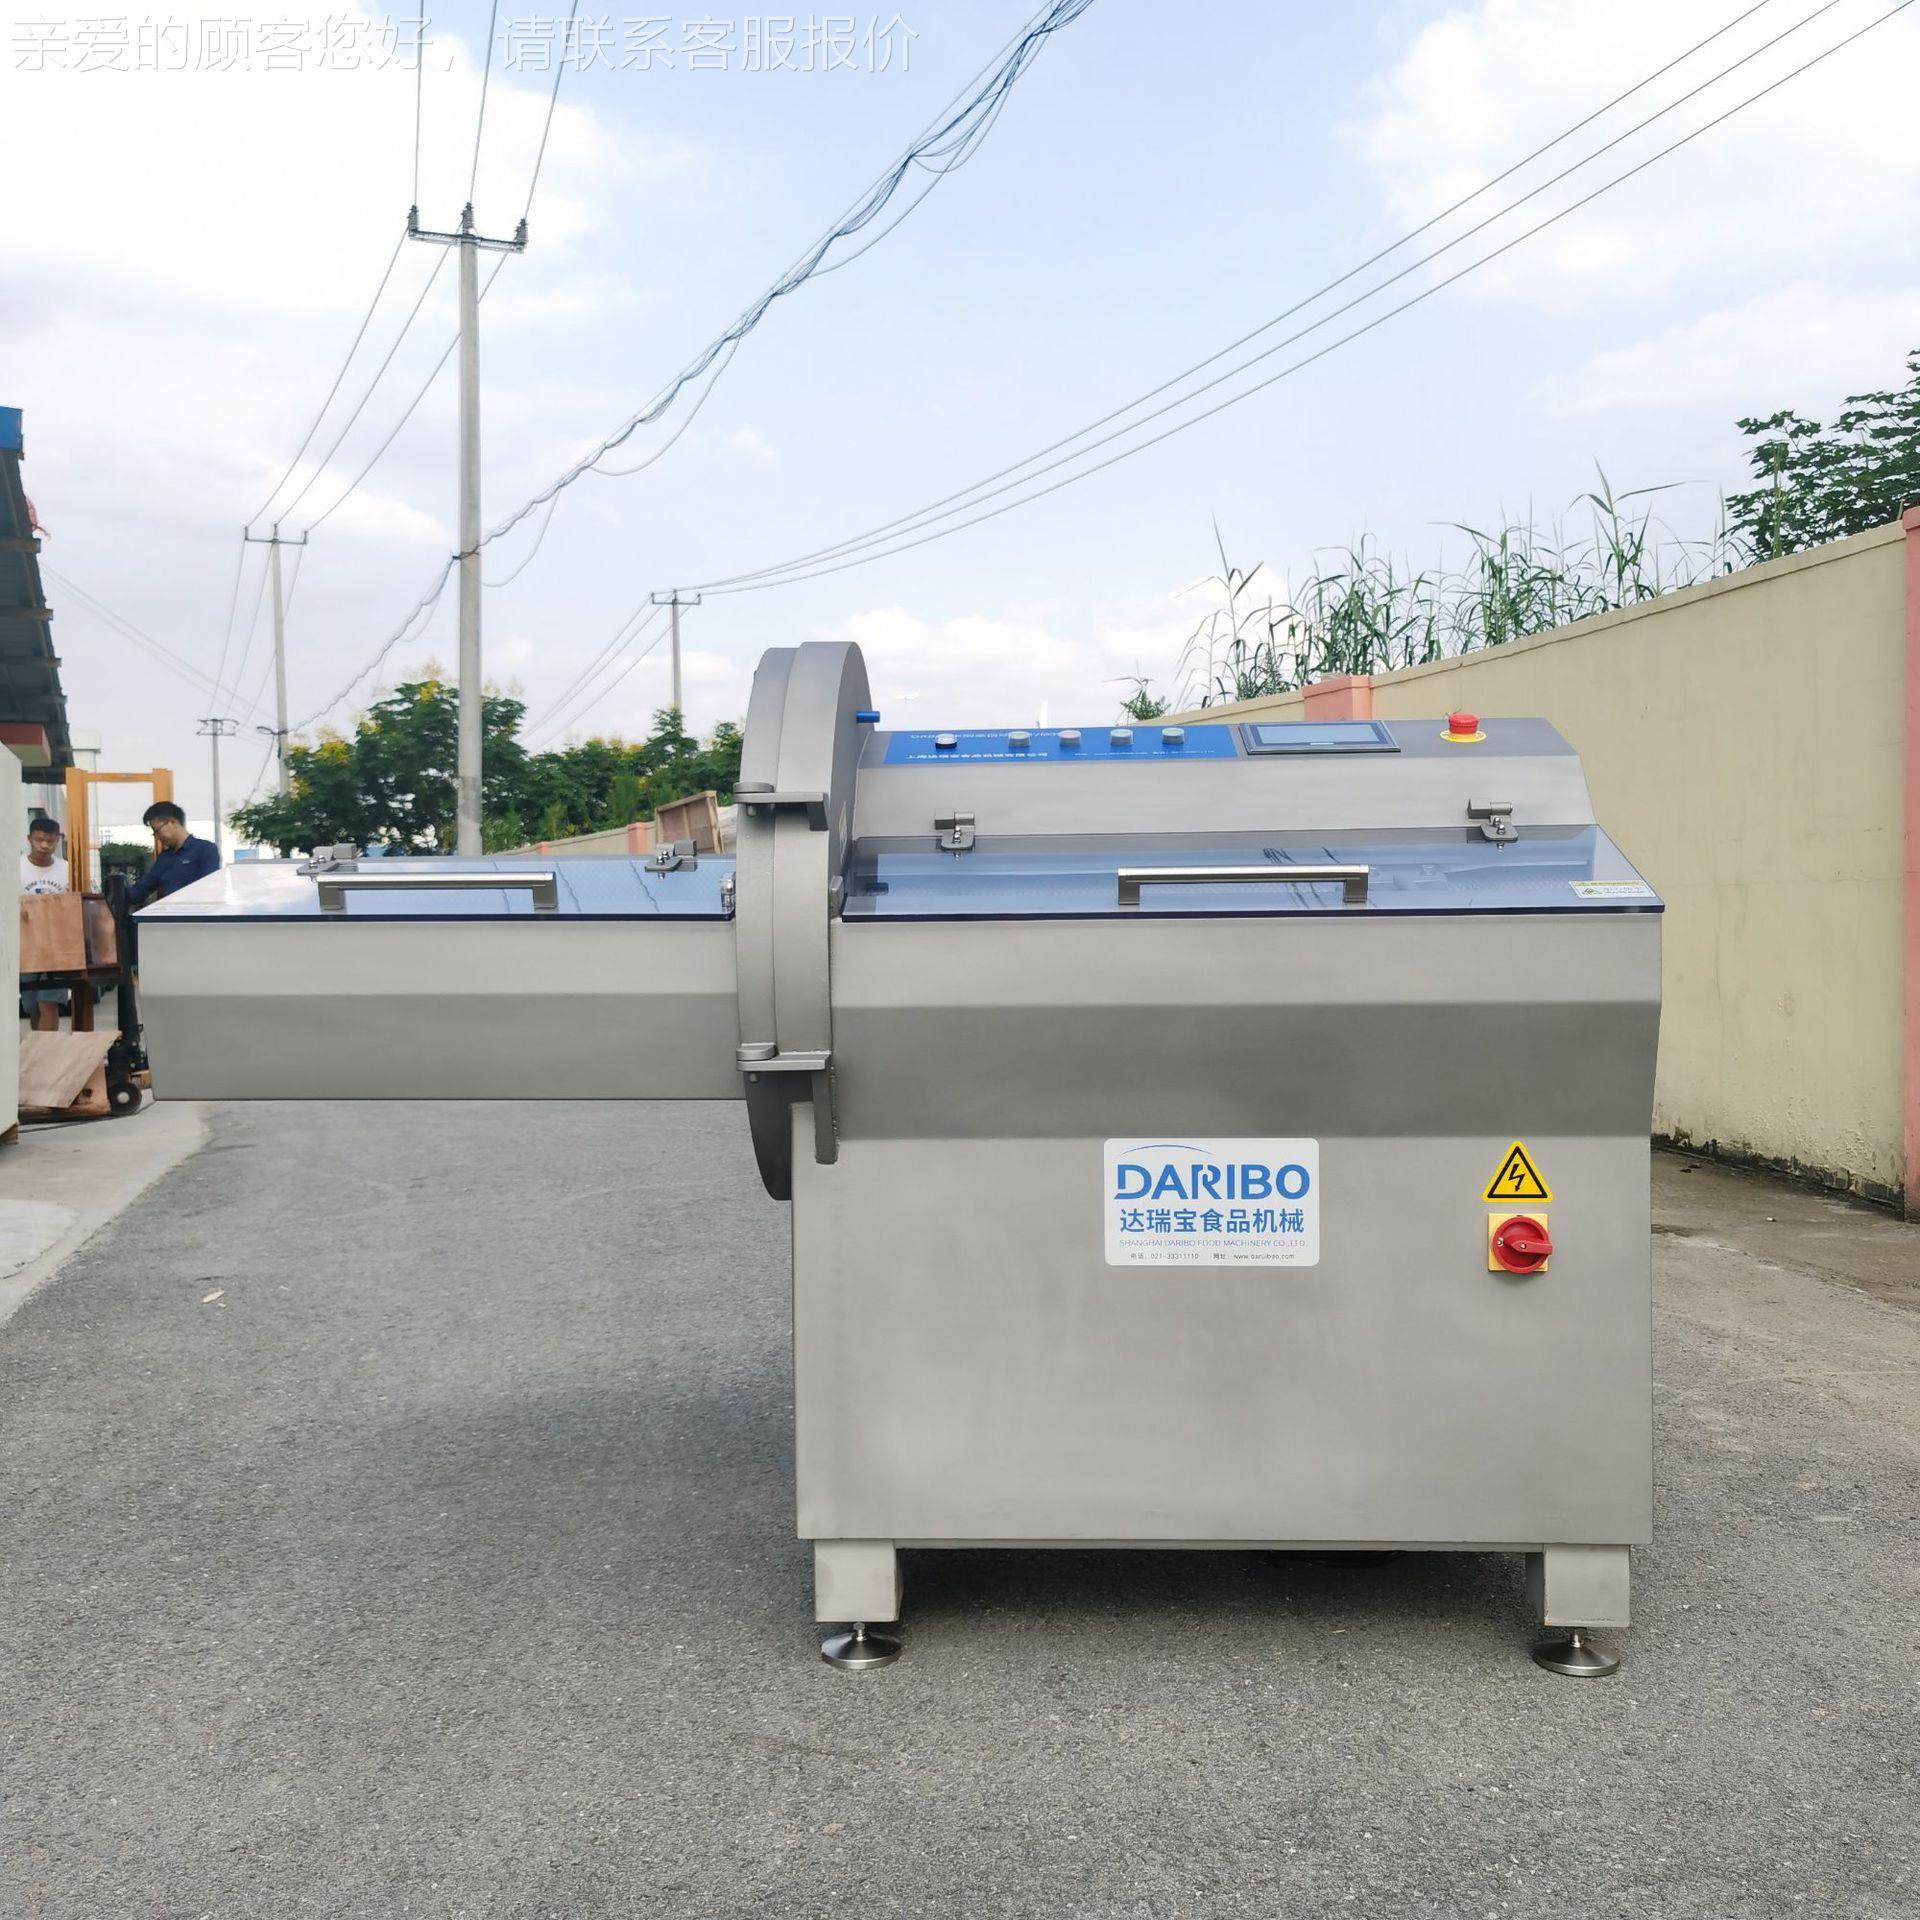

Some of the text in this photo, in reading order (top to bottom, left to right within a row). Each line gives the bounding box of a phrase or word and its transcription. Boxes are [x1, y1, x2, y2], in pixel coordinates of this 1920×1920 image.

[1114, 1164, 1310, 1200] DARIBO
[1120, 1208, 1304, 1233] 达瑞宝食品机械
[1119, 1239, 1163, 1248] SHANGHAI
[1165, 1239, 1196, 1248] DARIBO
[1198, 1239, 1221, 1248] FOOD
[1223, 1239, 1272, 1248] MACHINERY
